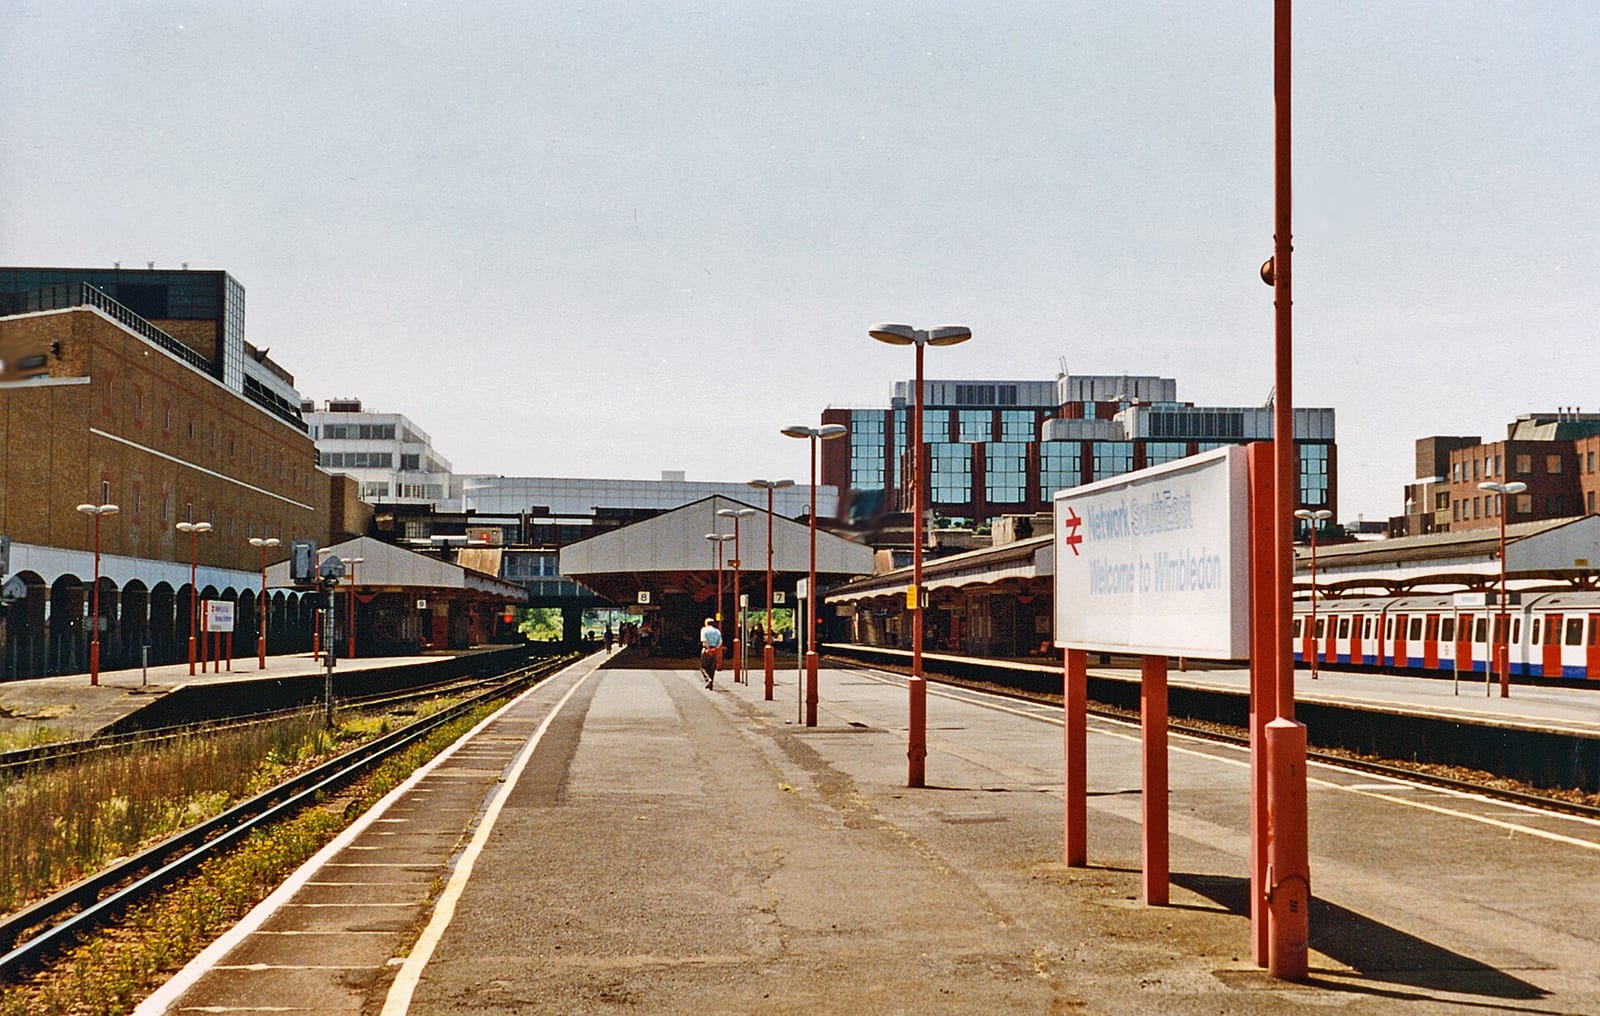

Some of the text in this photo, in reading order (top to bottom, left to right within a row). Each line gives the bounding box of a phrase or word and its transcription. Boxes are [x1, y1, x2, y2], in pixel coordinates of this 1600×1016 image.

[1087, 499, 1130, 542] Network
[1090, 547, 1221, 594] Welcome to Wimbledon
[640, 593, 648, 602] 8
[775, 593, 783, 601] 7
